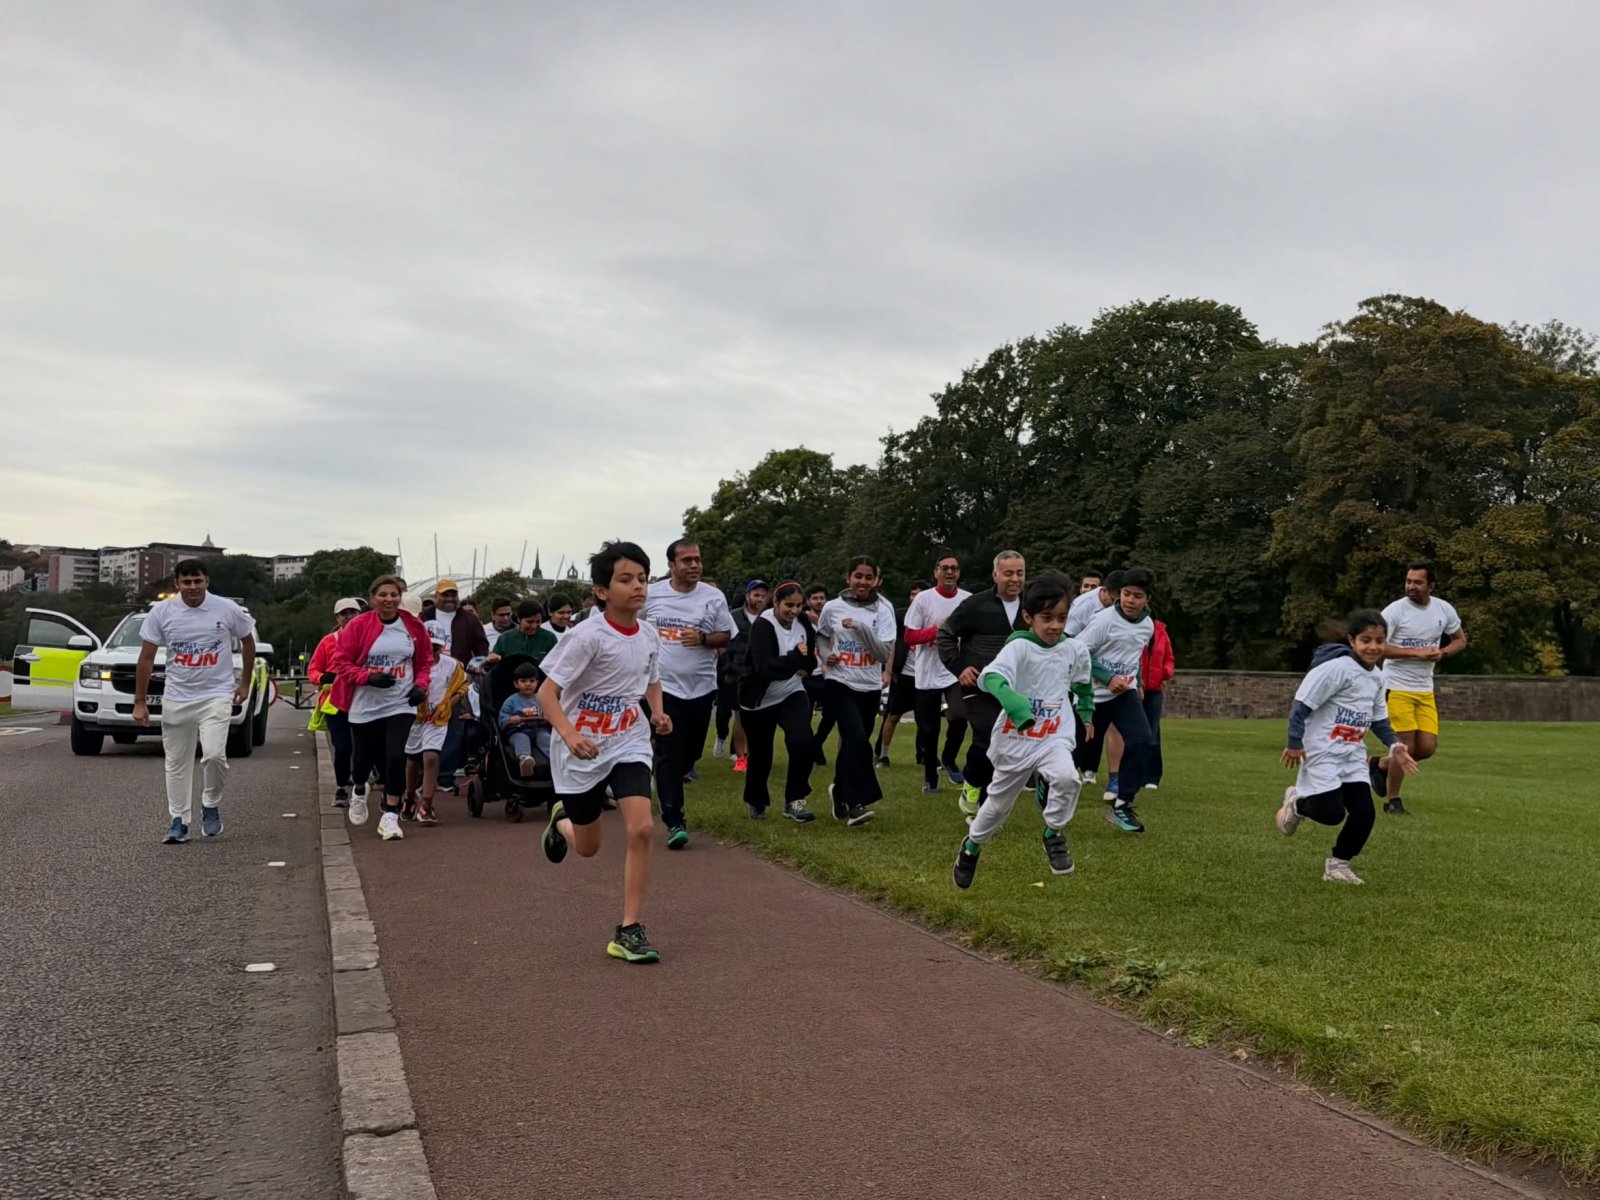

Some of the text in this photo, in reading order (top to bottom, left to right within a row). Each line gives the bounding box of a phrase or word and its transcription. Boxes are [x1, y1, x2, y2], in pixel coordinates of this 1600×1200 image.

[174, 652, 219, 667] RUN
[837, 651, 876, 667] RUN
[1101, 658, 1126, 670] VIKSIT
[582, 692, 623, 705] VIKSIT
[578, 700, 630, 714] BHARAT
[1337, 707, 1368, 721] VIKSIT
[575, 707, 640, 735] RUN
